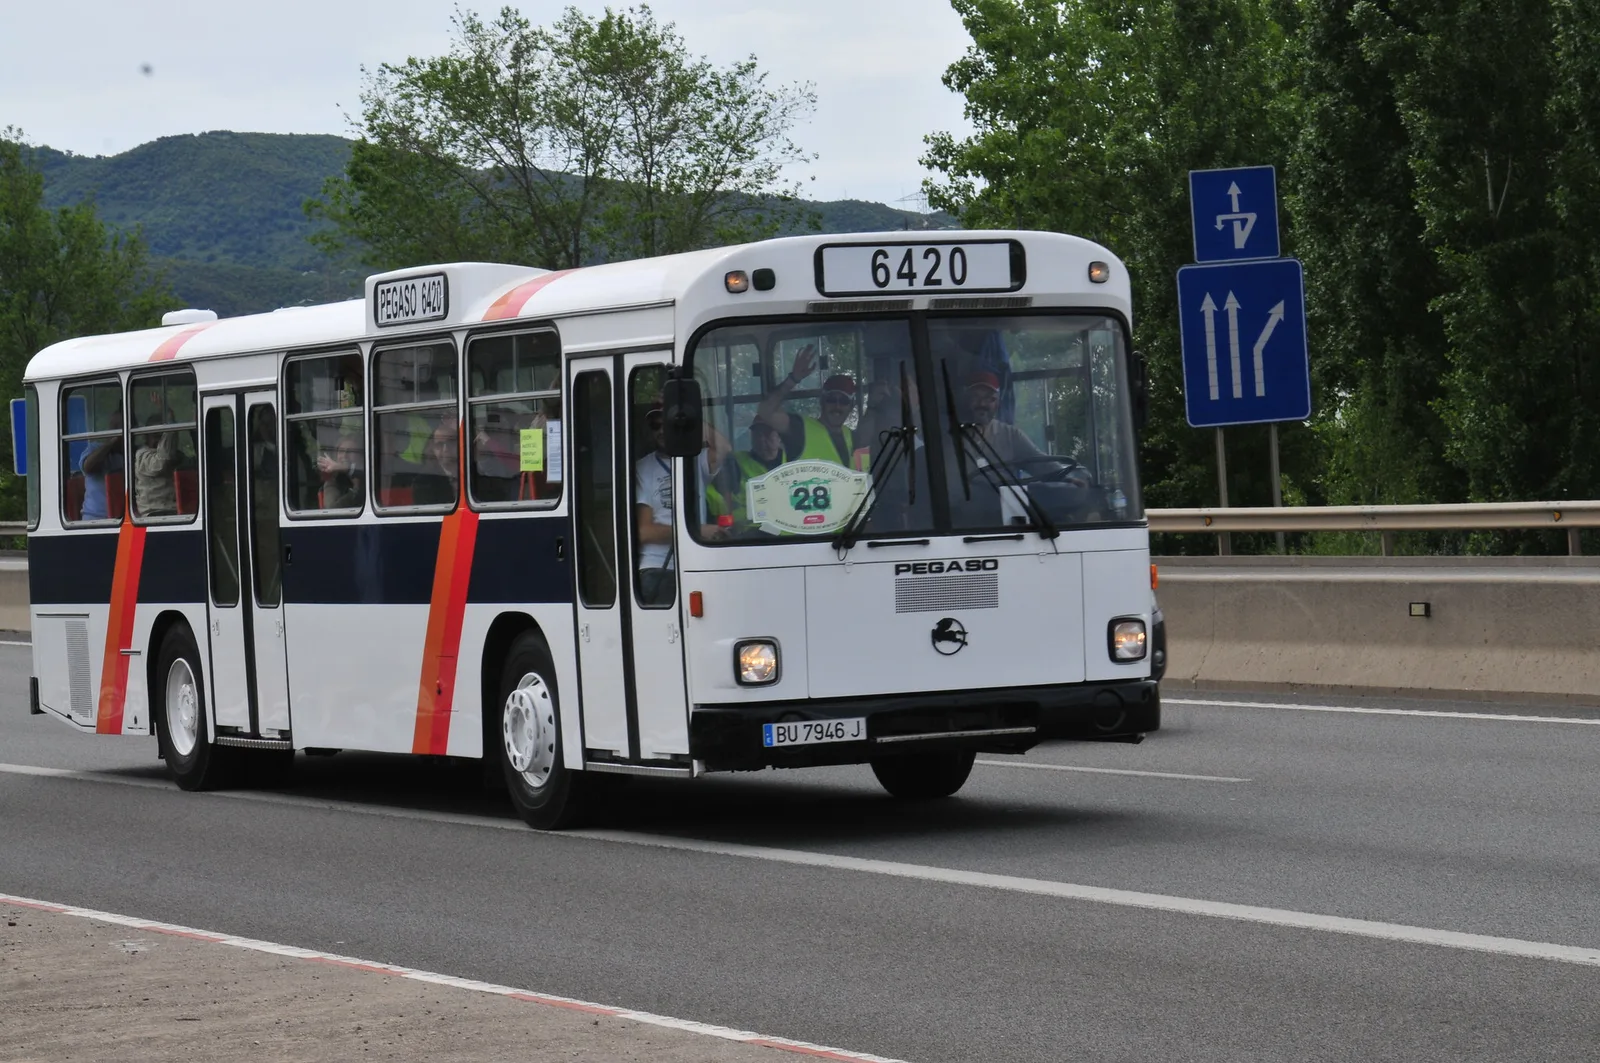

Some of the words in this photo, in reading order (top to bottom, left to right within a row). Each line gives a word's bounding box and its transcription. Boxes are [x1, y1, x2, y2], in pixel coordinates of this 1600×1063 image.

[871, 246, 968, 289] 6420
[380, 283, 417, 321] PEGASO
[421, 280, 441, 314] 6420
[793, 485, 831, 511] 28
[894, 559, 999, 576] PEGASO
[776, 724, 798, 743] BU
[803, 722, 845, 742] 7946
[850, 720, 860, 738] J
